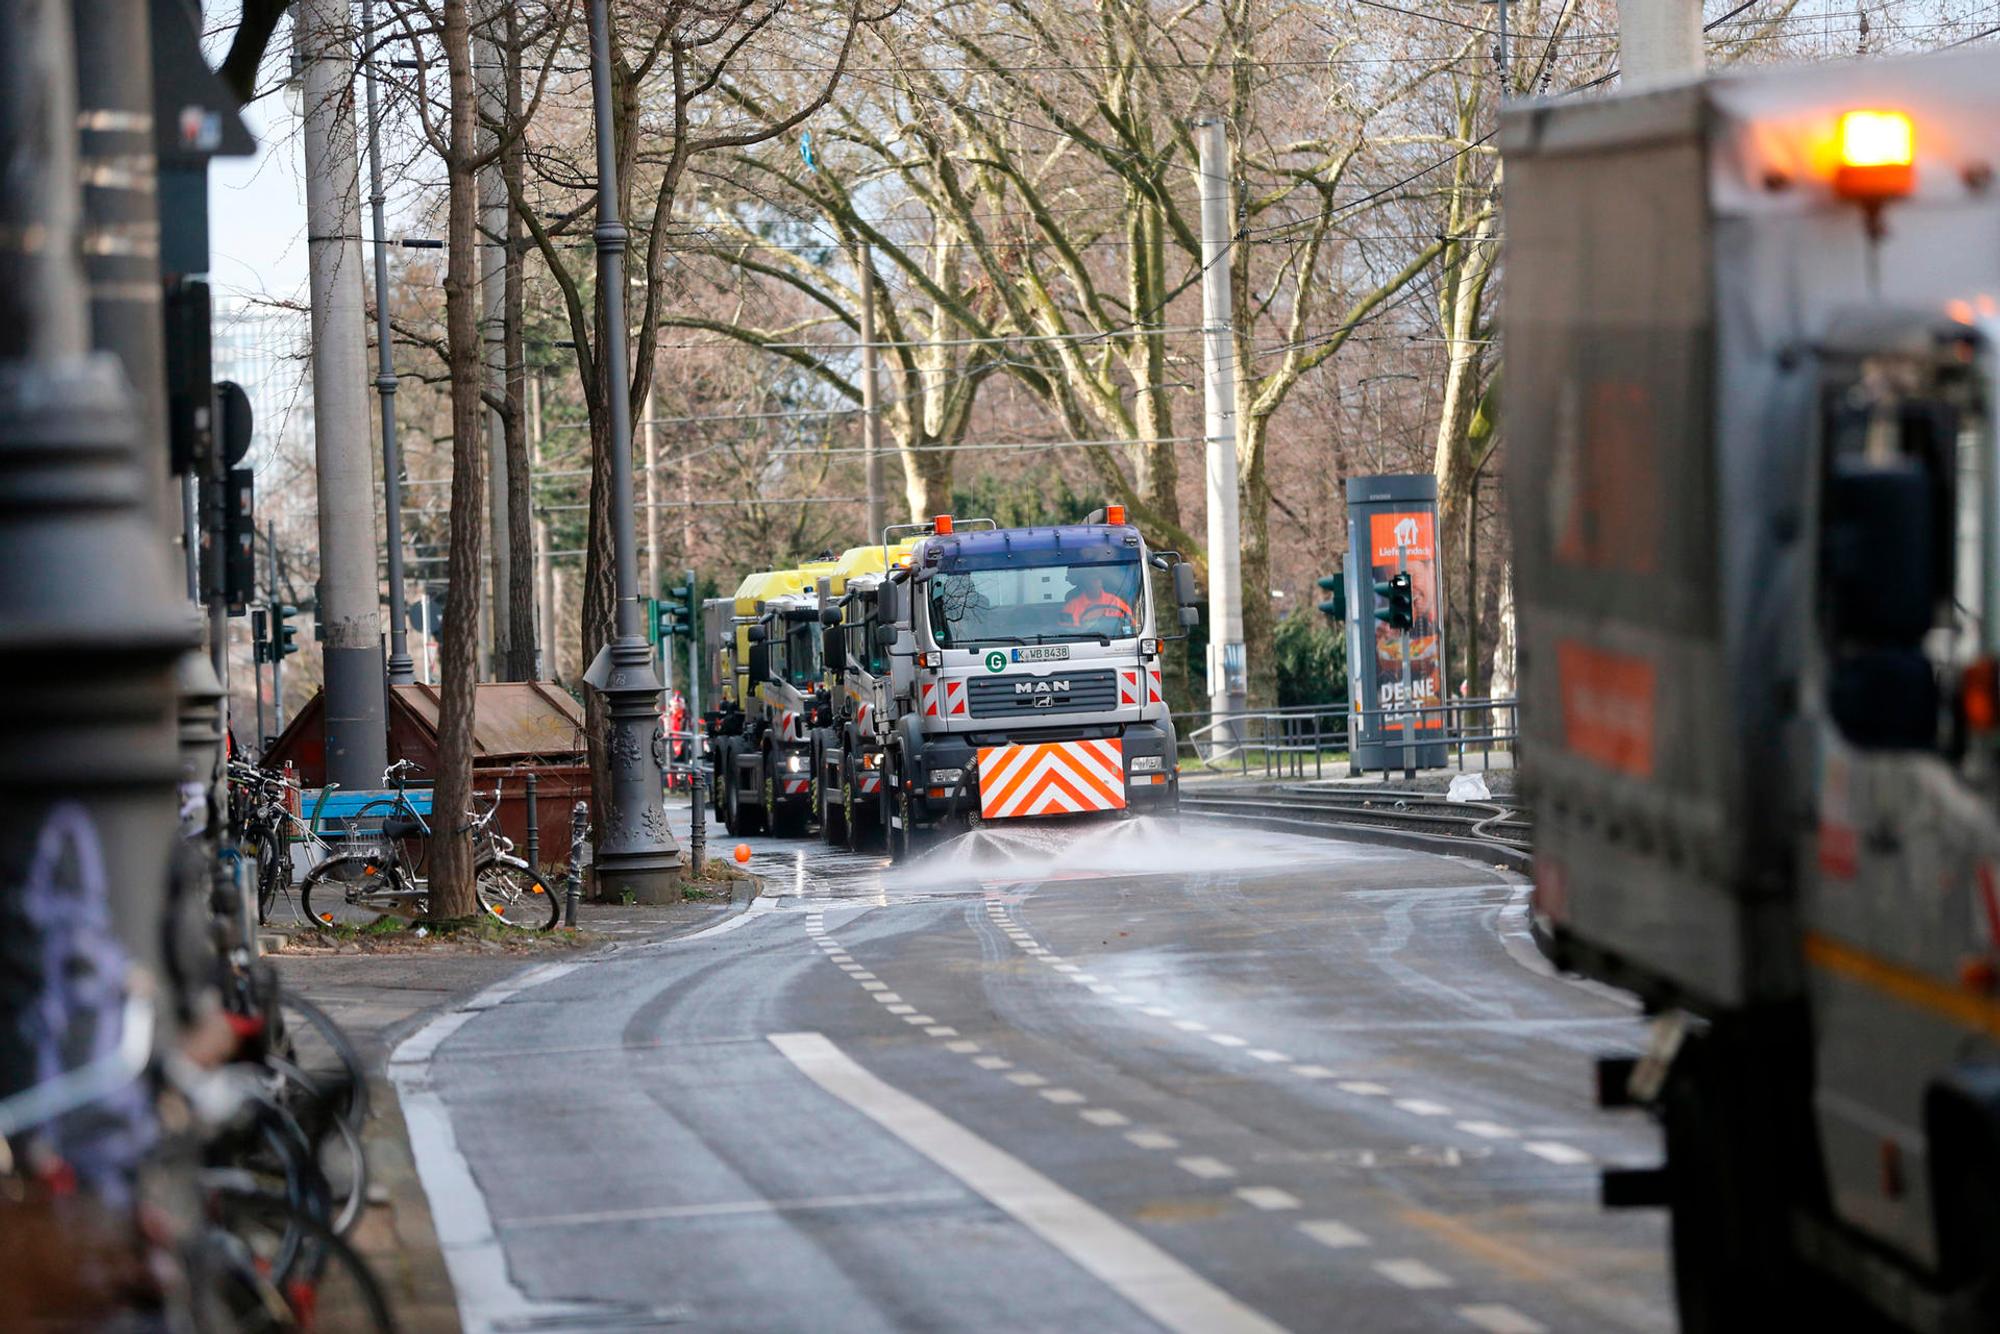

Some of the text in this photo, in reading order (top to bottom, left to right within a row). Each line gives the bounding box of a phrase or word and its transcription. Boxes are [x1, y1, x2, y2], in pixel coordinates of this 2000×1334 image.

[1029, 649, 1043, 659] WB
[1044, 647, 1067, 658] 8438
[991, 655, 1002, 669] G
[1015, 680, 1070, 694] MAN
[1381, 678, 1435, 702] DENE
[1381, 699, 1425, 722] ZET
